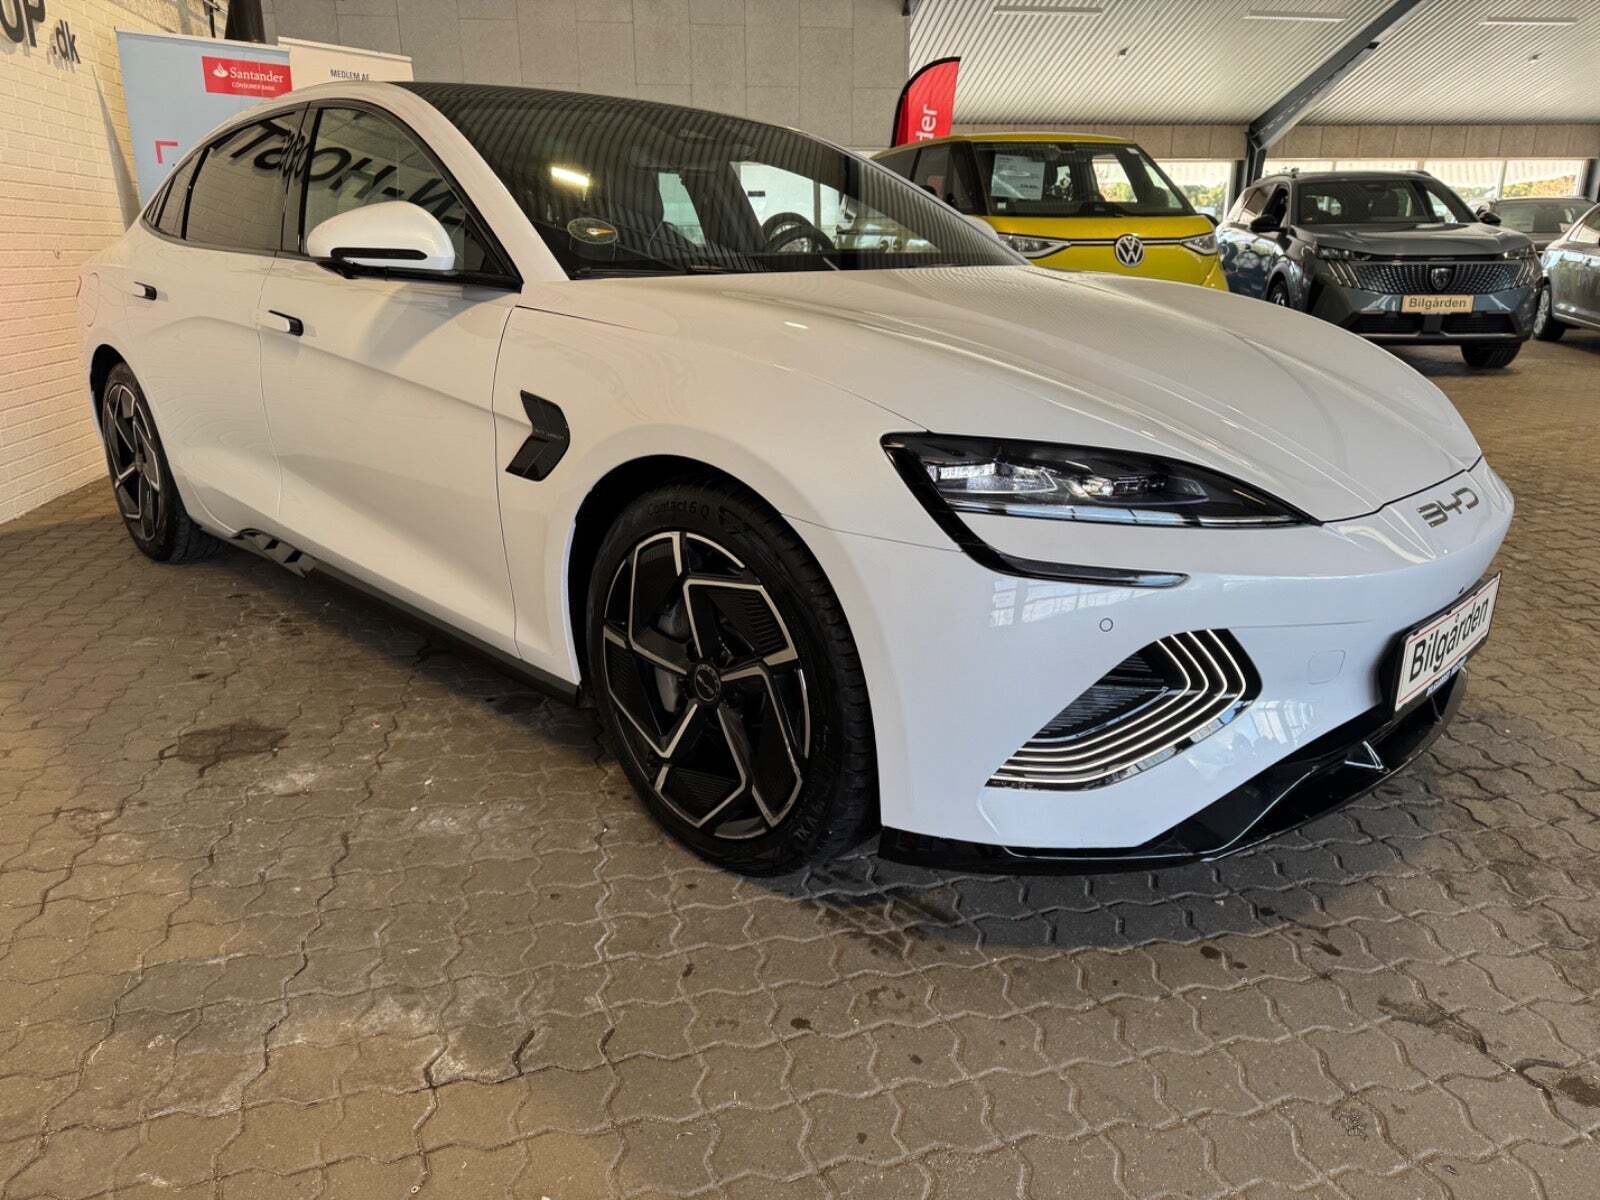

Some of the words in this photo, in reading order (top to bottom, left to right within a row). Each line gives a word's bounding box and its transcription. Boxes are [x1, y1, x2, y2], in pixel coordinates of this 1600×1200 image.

[52, 19, 81, 64] .dk
[230, 66, 284, 83] Santander
[1408, 296, 1467, 309] Bilgården
[1416, 487, 1480, 529] BYD
[1408, 597, 1489, 684] Bilgården
